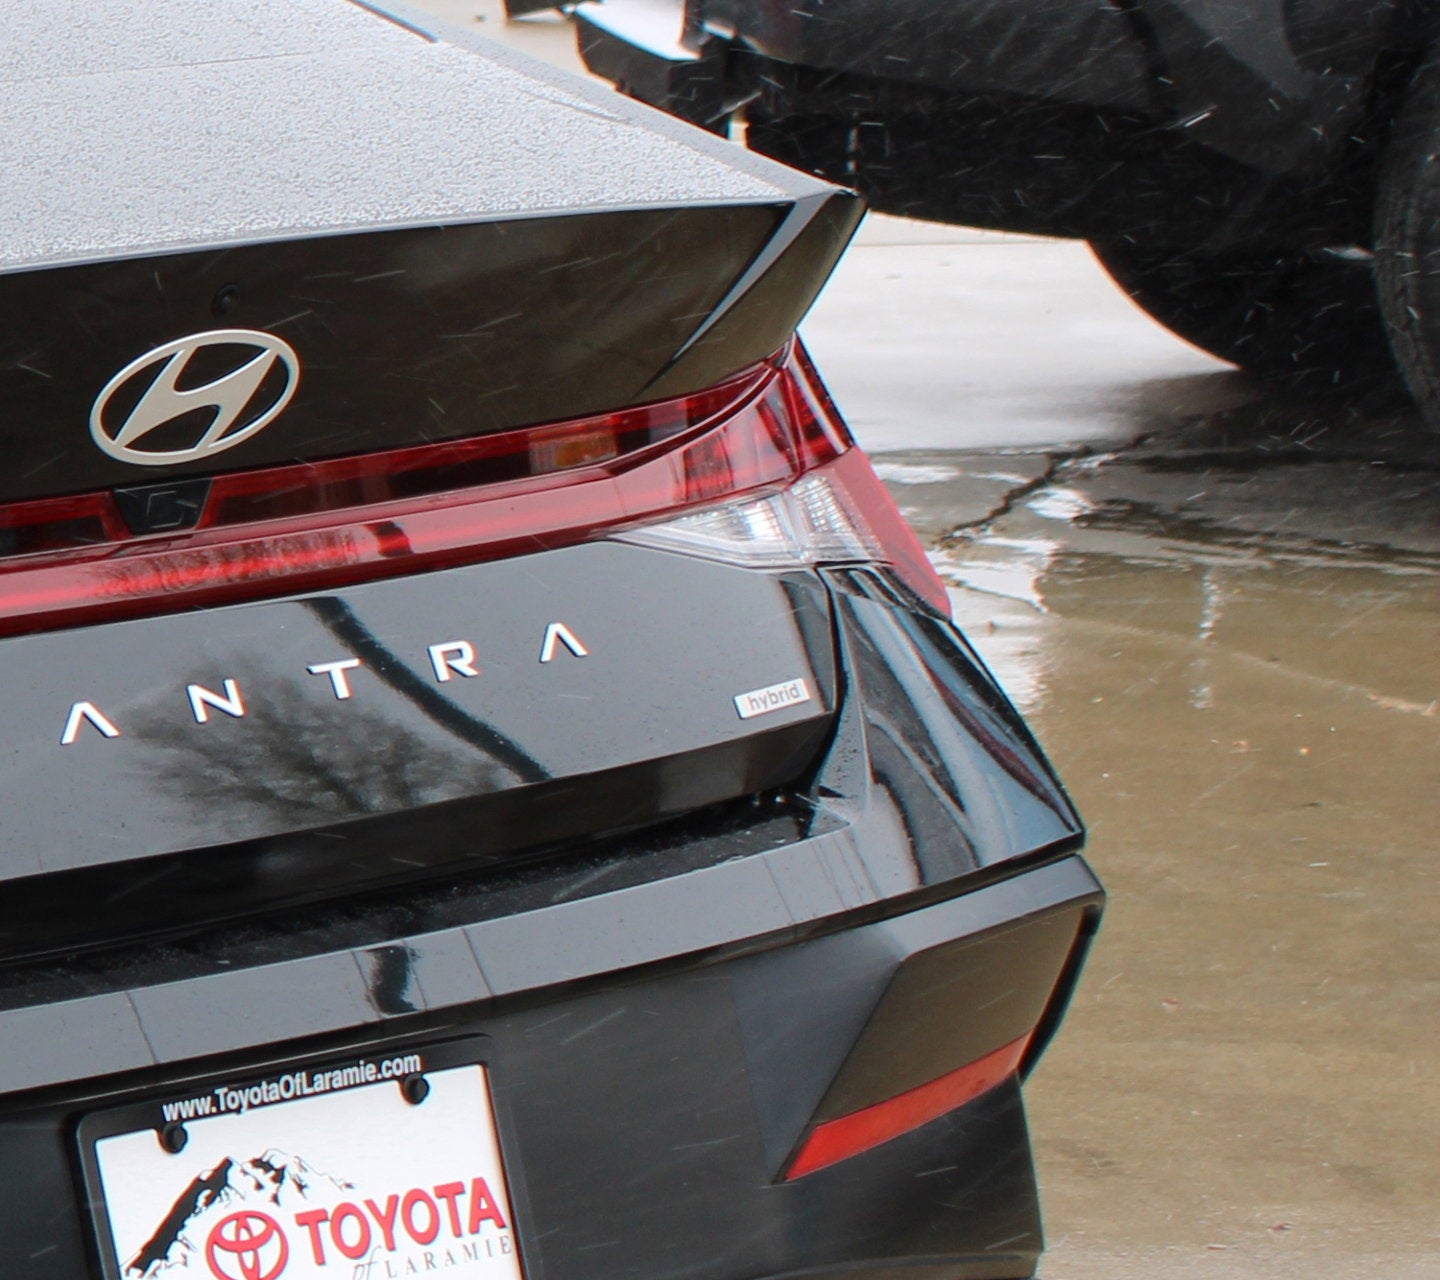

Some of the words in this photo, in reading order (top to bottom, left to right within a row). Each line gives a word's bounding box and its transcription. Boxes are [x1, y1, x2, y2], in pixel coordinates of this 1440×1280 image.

[747, 683, 800, 711] hybrid
[162, 1053, 422, 1122] www.ToyotaOfLaramie.com
[294, 1176, 508, 1267] TOYOTA
[384, 1235, 513, 1280] LARAMIE
